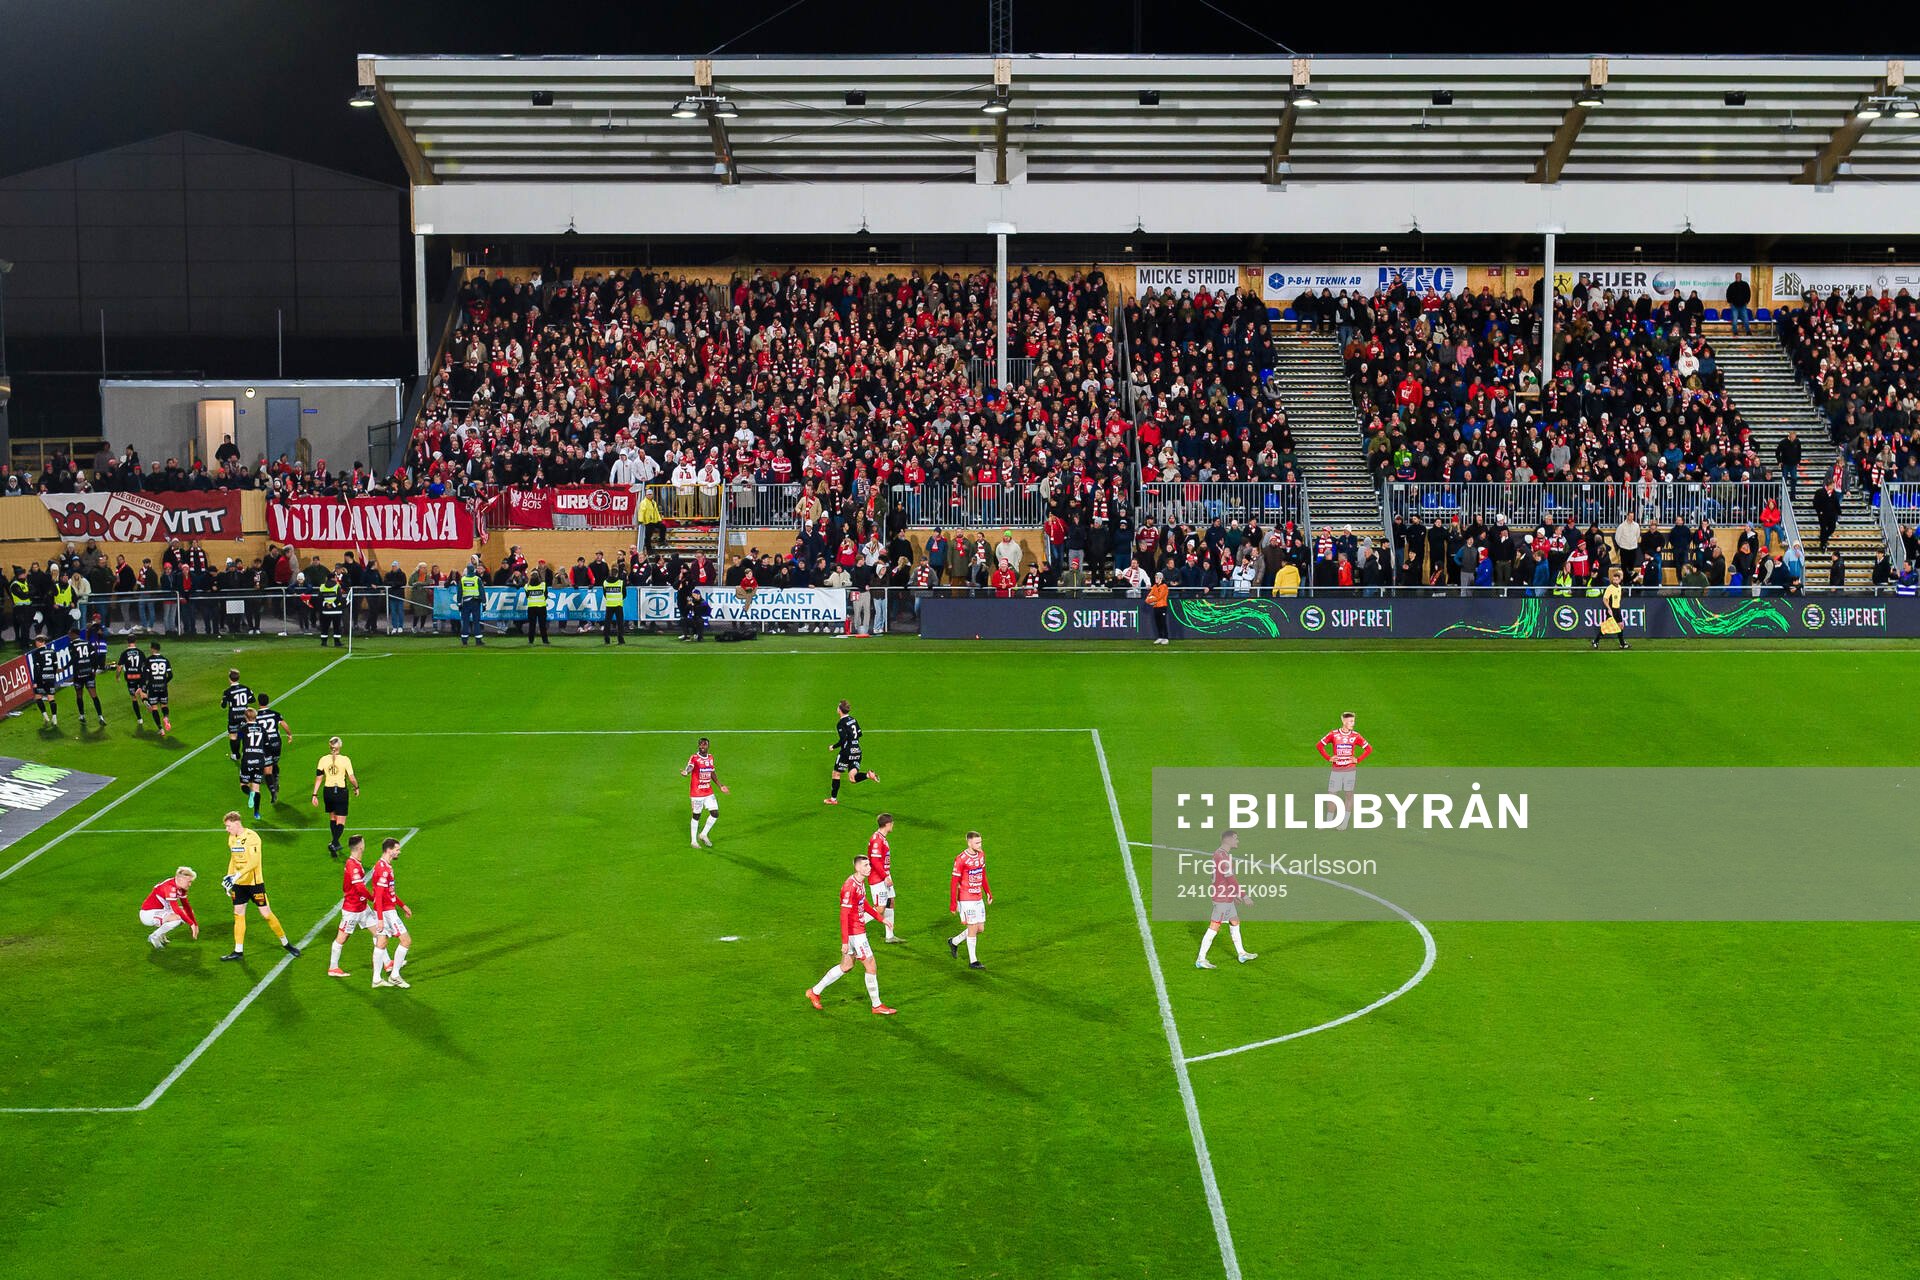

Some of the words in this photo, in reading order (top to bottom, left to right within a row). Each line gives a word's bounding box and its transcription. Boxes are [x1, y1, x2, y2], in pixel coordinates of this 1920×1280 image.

[1139, 268, 1183, 285] MICKE
[1188, 268, 1236, 285] STRIDH
[1315, 276, 1347, 285] TEKNIK
[1349, 276, 1361, 285] AB
[1578, 272, 1647, 287] BEIJER
[523, 491, 547, 501] VALLA
[557, 494, 589, 509] URB
[163, 509, 226, 533] VITT
[273, 502, 459, 542] VULKANERNA
[731, 606, 841, 620] VÅRDCENTRAL
[76, 645, 89, 658] 14
[45, 653, 52, 665] 5
[127, 655, 140, 667] 11
[151, 662, 167, 675] 99
[234, 692, 247, 706] 10
[851, 724, 858, 739] 3
[247, 732, 263, 746] 17
